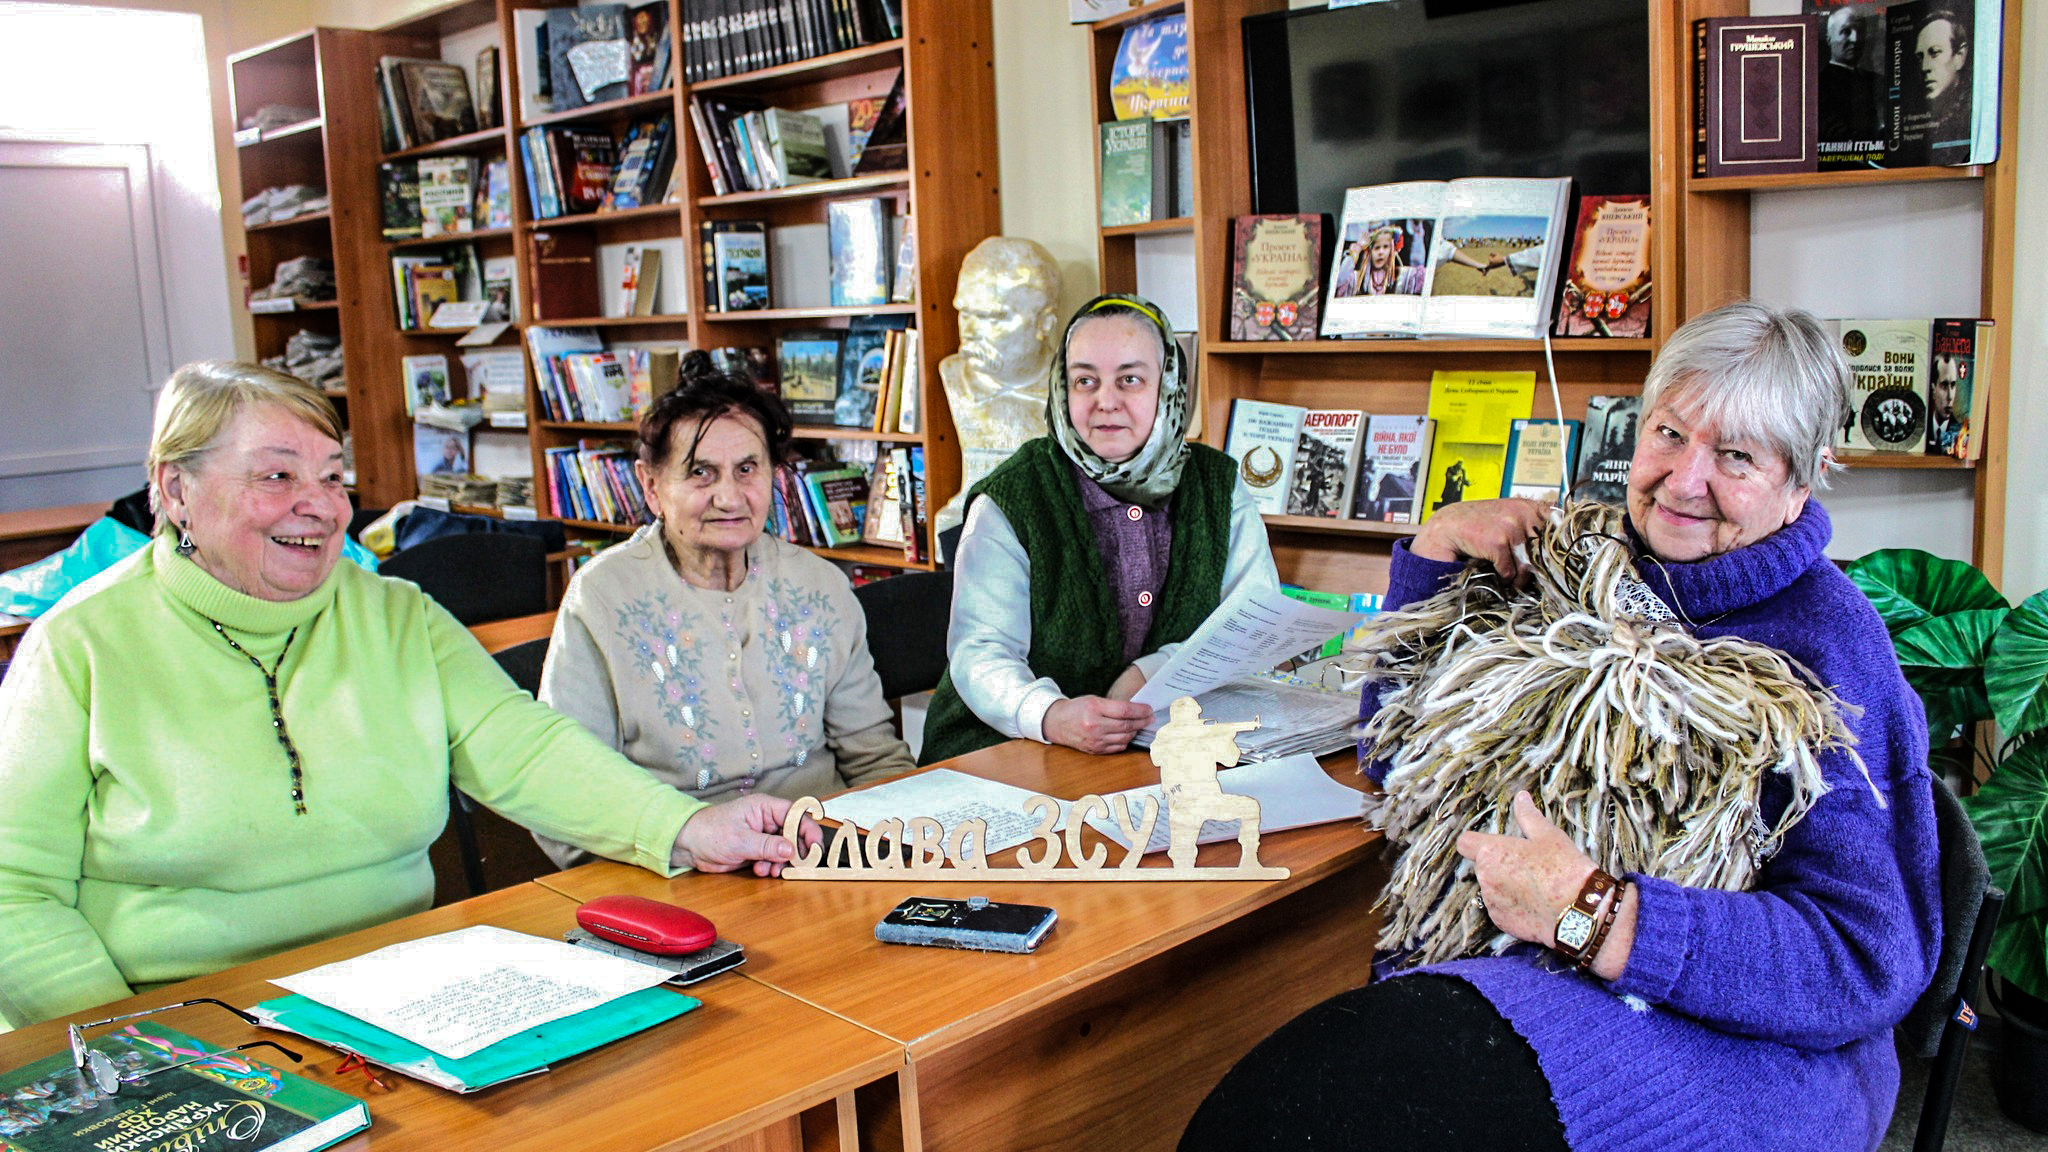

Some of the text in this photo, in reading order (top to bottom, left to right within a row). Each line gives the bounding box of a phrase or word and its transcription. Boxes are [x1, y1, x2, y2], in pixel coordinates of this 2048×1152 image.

[1729, 39, 1795, 53] ГРУШЕВСЬКИЙ
[1888, 40, 1903, 152] Симон Петлюра
[1817, 139, 1885, 153] СТАННІЙ ГЕТЬМ
[1261, 242, 1297, 255] Проект
[1935, 332, 1972, 355] Бандера
[1884, 351, 1915, 365] Вони
[1848, 364, 1915, 373] оролися за волю
[1304, 413, 1360, 427] АЕРОПОРТ
[1399, 430, 1417, 443] ЯКОЇ
[1377, 444, 1408, 455] НЕ БУЛО
[783, 796, 989, 870] Слава
[1015, 794, 1159, 870] ЗСУ
[93, 1101, 203, 1150] НАРОДНИЙ
[117, 1108, 159, 1130] ХОР
[131, 1099, 267, 1152] Співа
